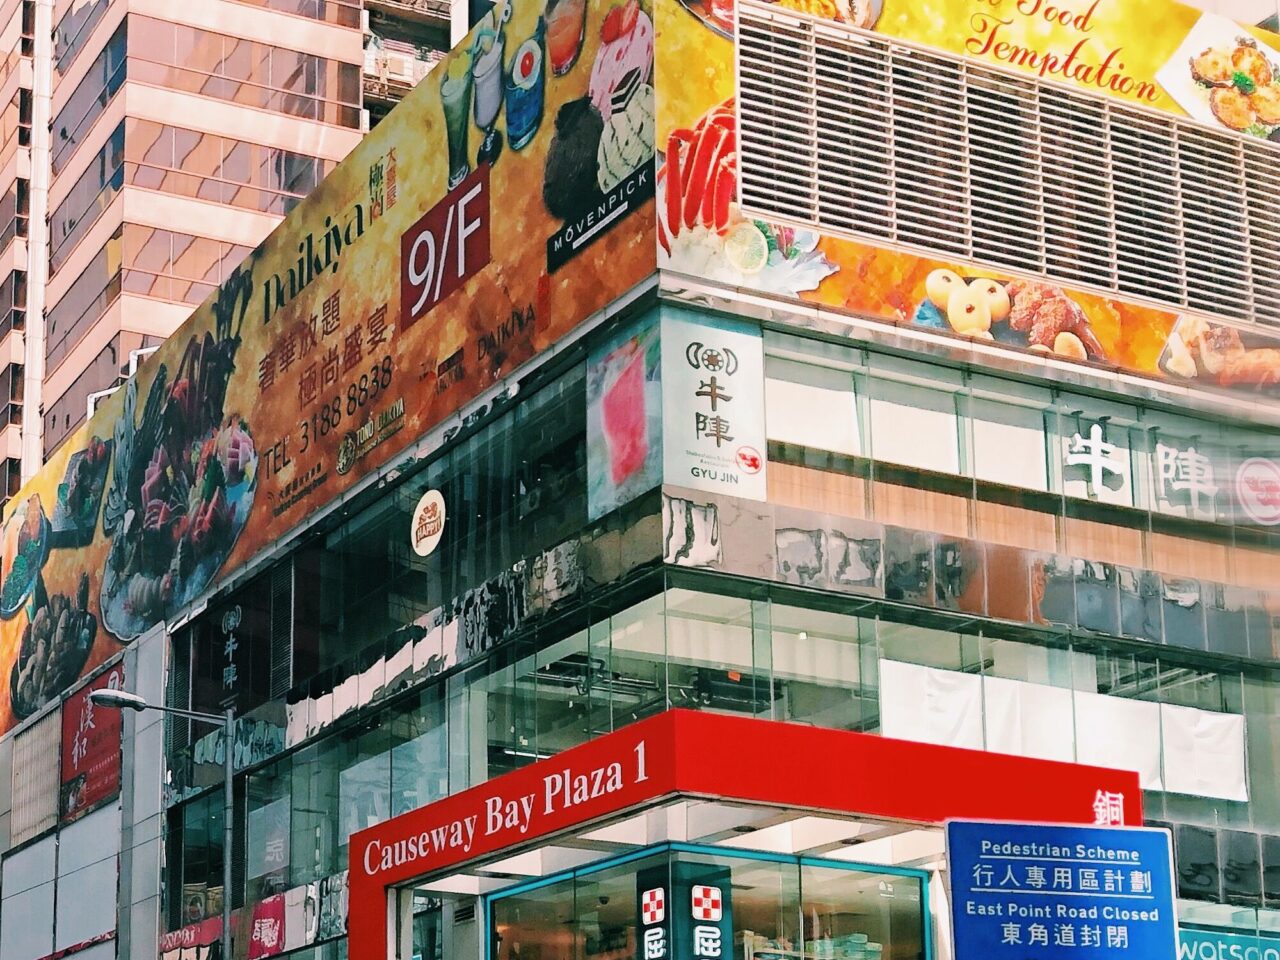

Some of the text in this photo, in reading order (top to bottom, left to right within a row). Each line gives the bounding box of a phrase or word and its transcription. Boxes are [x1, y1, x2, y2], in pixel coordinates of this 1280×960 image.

[965, 13, 1160, 101] Temptation
[408, 181, 482, 318] 9/F
[258, 289, 341, 395] 奢華放題
[298, 302, 389, 411] 極尚盛宴
[263, 438, 291, 480] TEL
[300, 396, 342, 454] 3188
[346, 354, 393, 416] 8838
[695, 376, 735, 448] 牛陣
[691, 467, 739, 484] GYU JIN
[1065, 423, 1219, 518] 牛陣
[363, 740, 650, 877] Causeway Bay Plaza 1
[981, 840, 1140, 862] Pedestrian Scheme
[966, 900, 1160, 922] East Point Road Closed
[972, 863, 1152, 894] 行人專用區計劃
[1000, 921, 1129, 949] 東角道封閉
